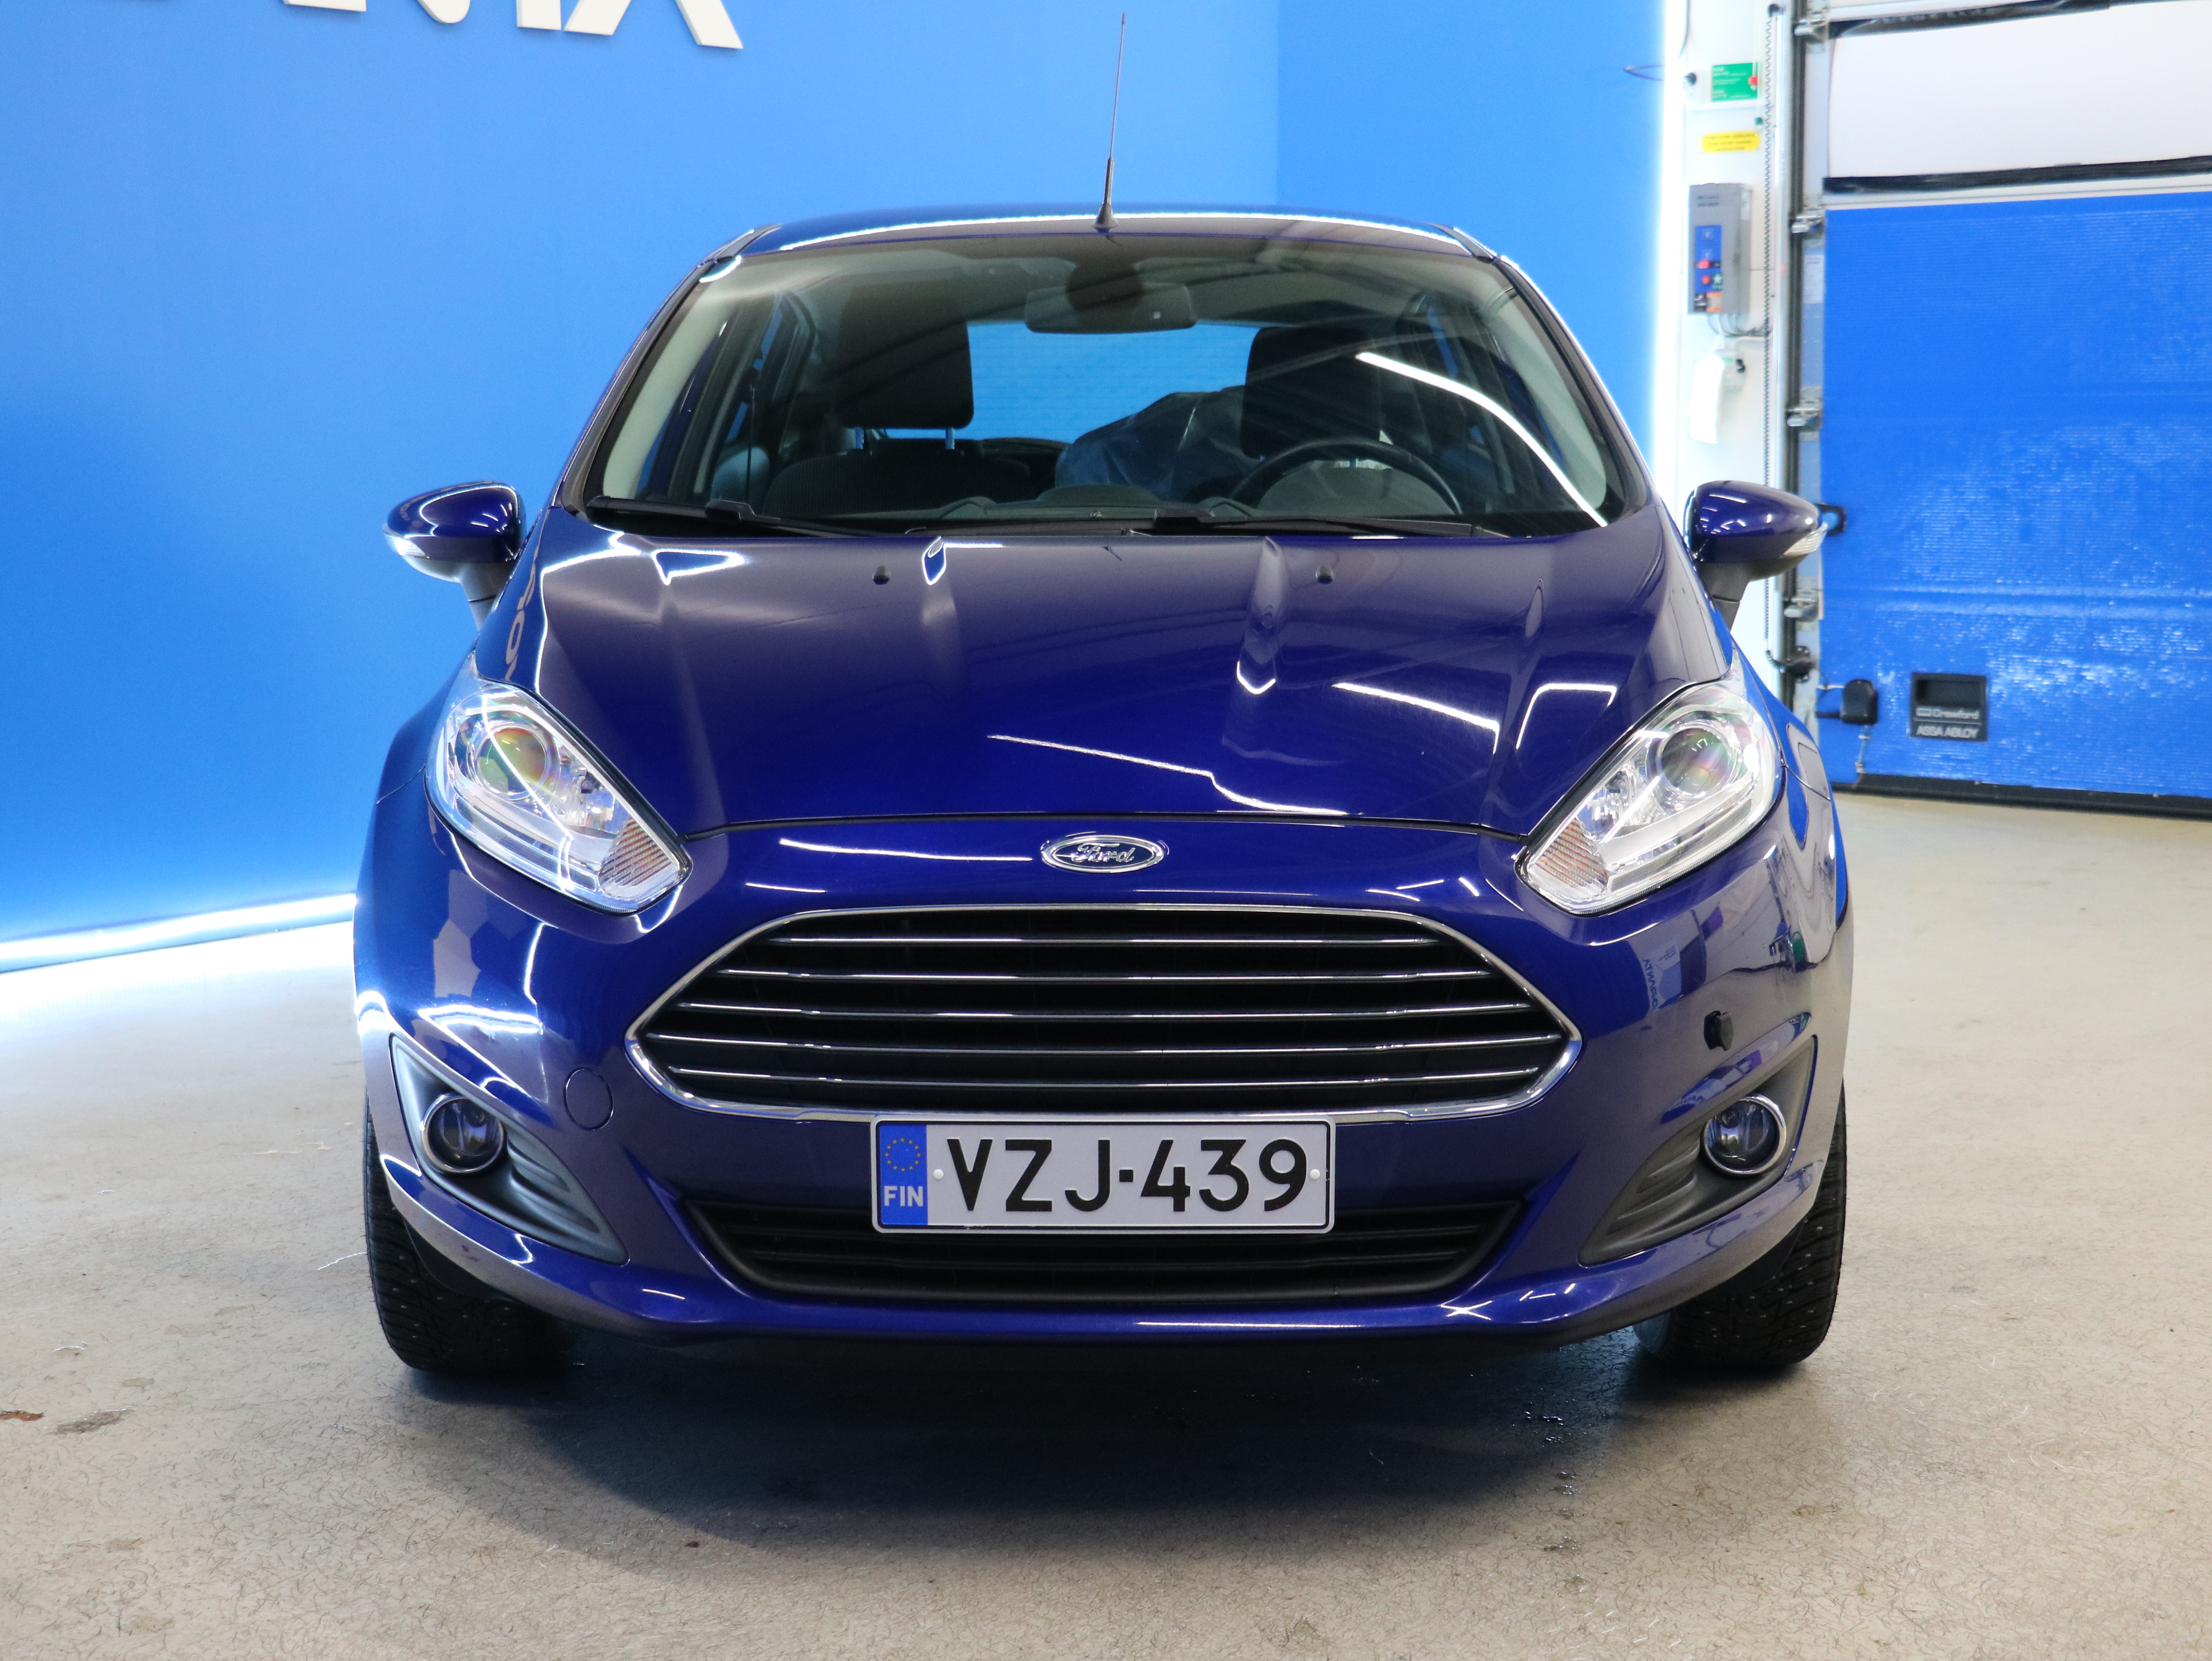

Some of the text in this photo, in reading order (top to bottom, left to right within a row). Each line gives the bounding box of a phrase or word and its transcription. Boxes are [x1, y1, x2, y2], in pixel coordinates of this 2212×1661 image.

[1916, 725, 1979, 739] ASSA ABLOY
[1070, 843, 1136, 863] Ford
[947, 1139, 1307, 1212] VZJ-439
[884, 1186, 923, 1207] FIN
